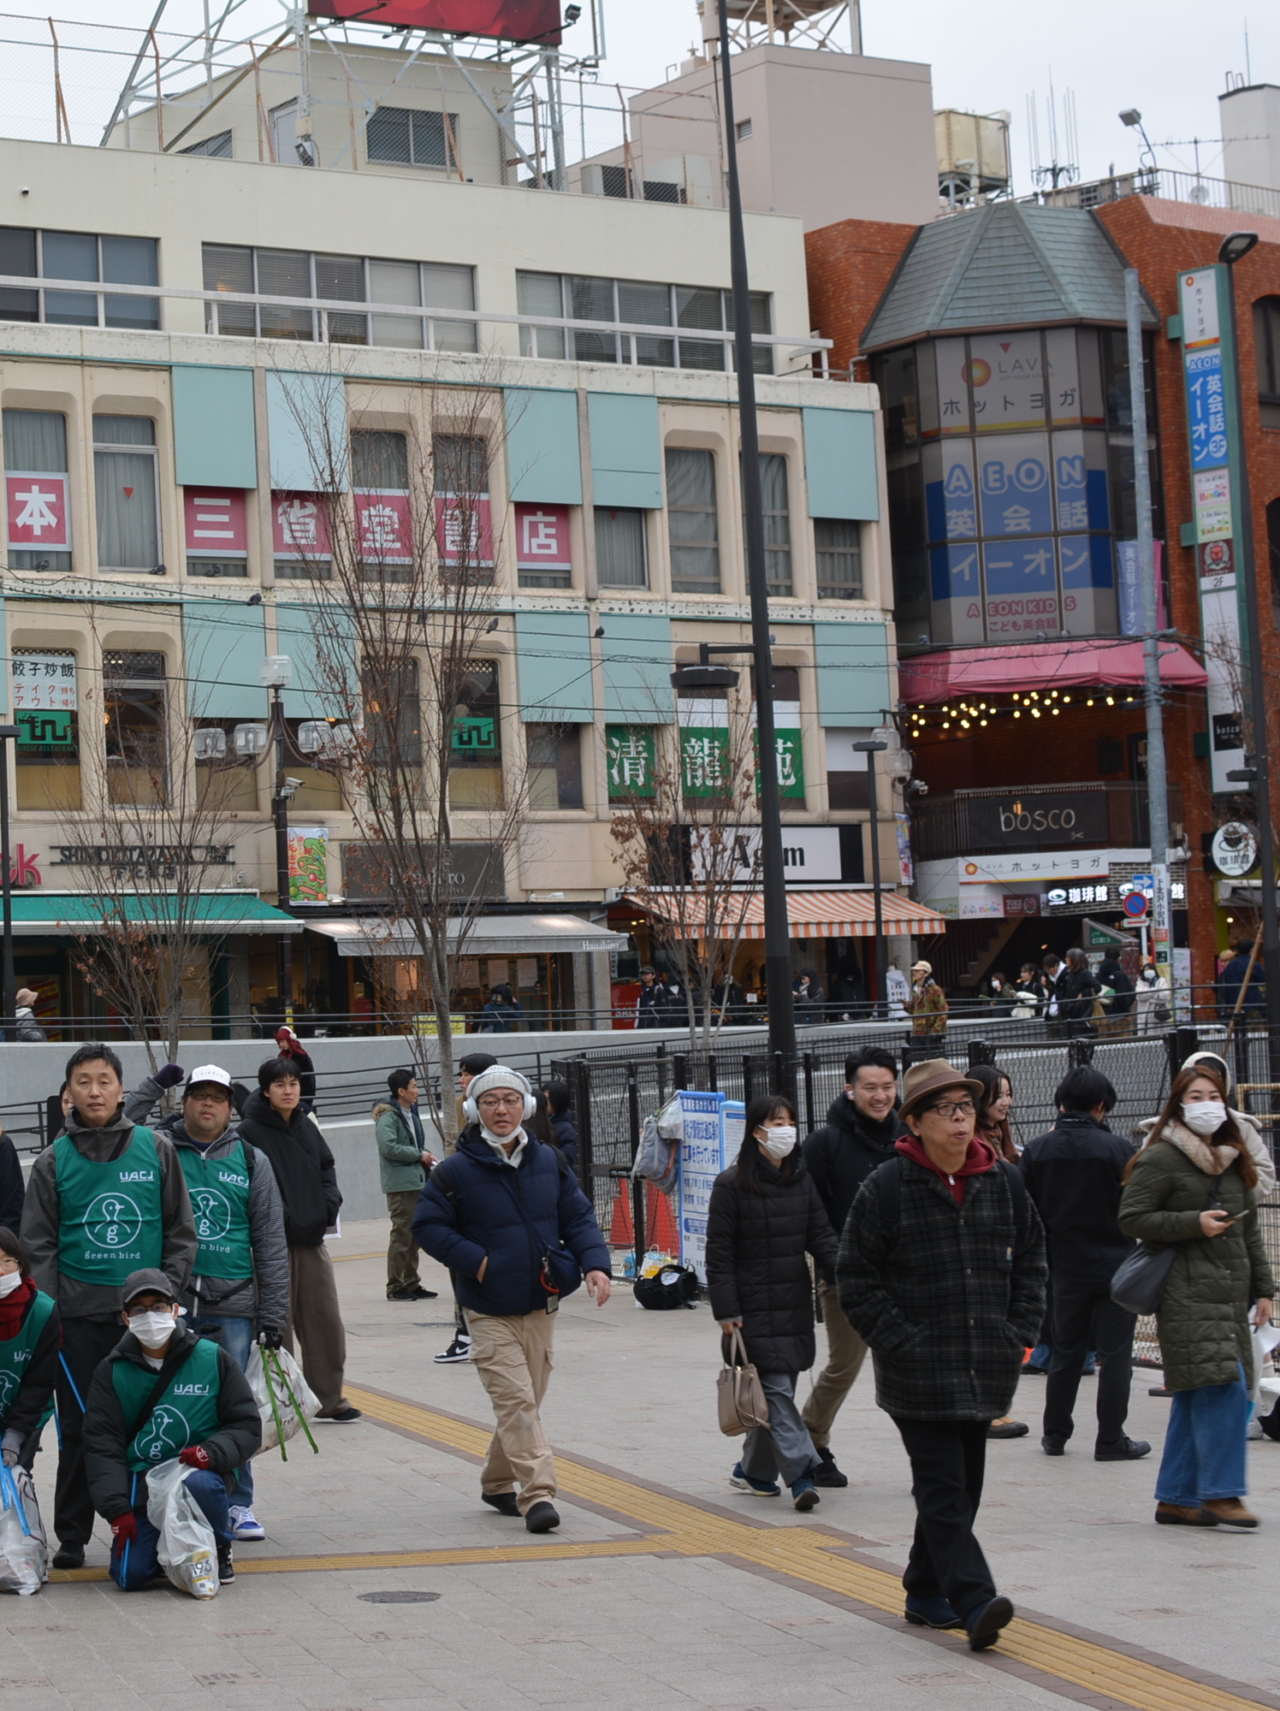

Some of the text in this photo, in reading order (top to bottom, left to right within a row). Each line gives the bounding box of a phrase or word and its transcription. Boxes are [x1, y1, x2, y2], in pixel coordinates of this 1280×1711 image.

[998, 357, 1054, 374] LAVA
[1189, 355, 1221, 371] AEON
[942, 388, 1078, 416] ホットヨガ
[1206, 374, 1225, 433] 英会話
[1190, 377, 1209, 463] イーオン
[946, 457, 1087, 496] AEON
[15, 485, 58, 536] 本
[945, 500, 1089, 538] 英会話
[192, 496, 558, 556] 三省堂書店
[951, 547, 1089, 582] イーオン
[1125, 547, 1138, 635] 英会話イーオン
[967, 596, 1077, 618] AEON KIDS
[988, 617, 1058, 633] こども英会話
[12, 661, 75, 678] 餃子炒飯
[14, 682, 56, 695] テイク
[14, 696, 56, 708] アウト
[609, 735, 798, 788] 清龍苑
[999, 800, 1076, 832] bosco
[1011, 857, 1102, 872] ホットヨガ
[1068, 885, 1109, 904] 珈琲館
[582, 940, 619, 951] Hanahiro
[120, 1170, 155, 1182] UACJ
[219, 1171, 250, 1187] UACJ
[85, 1250, 142, 1260] green bird
[209, 1244, 231, 1254] bird
[174, 1383, 210, 1396] UACJ
